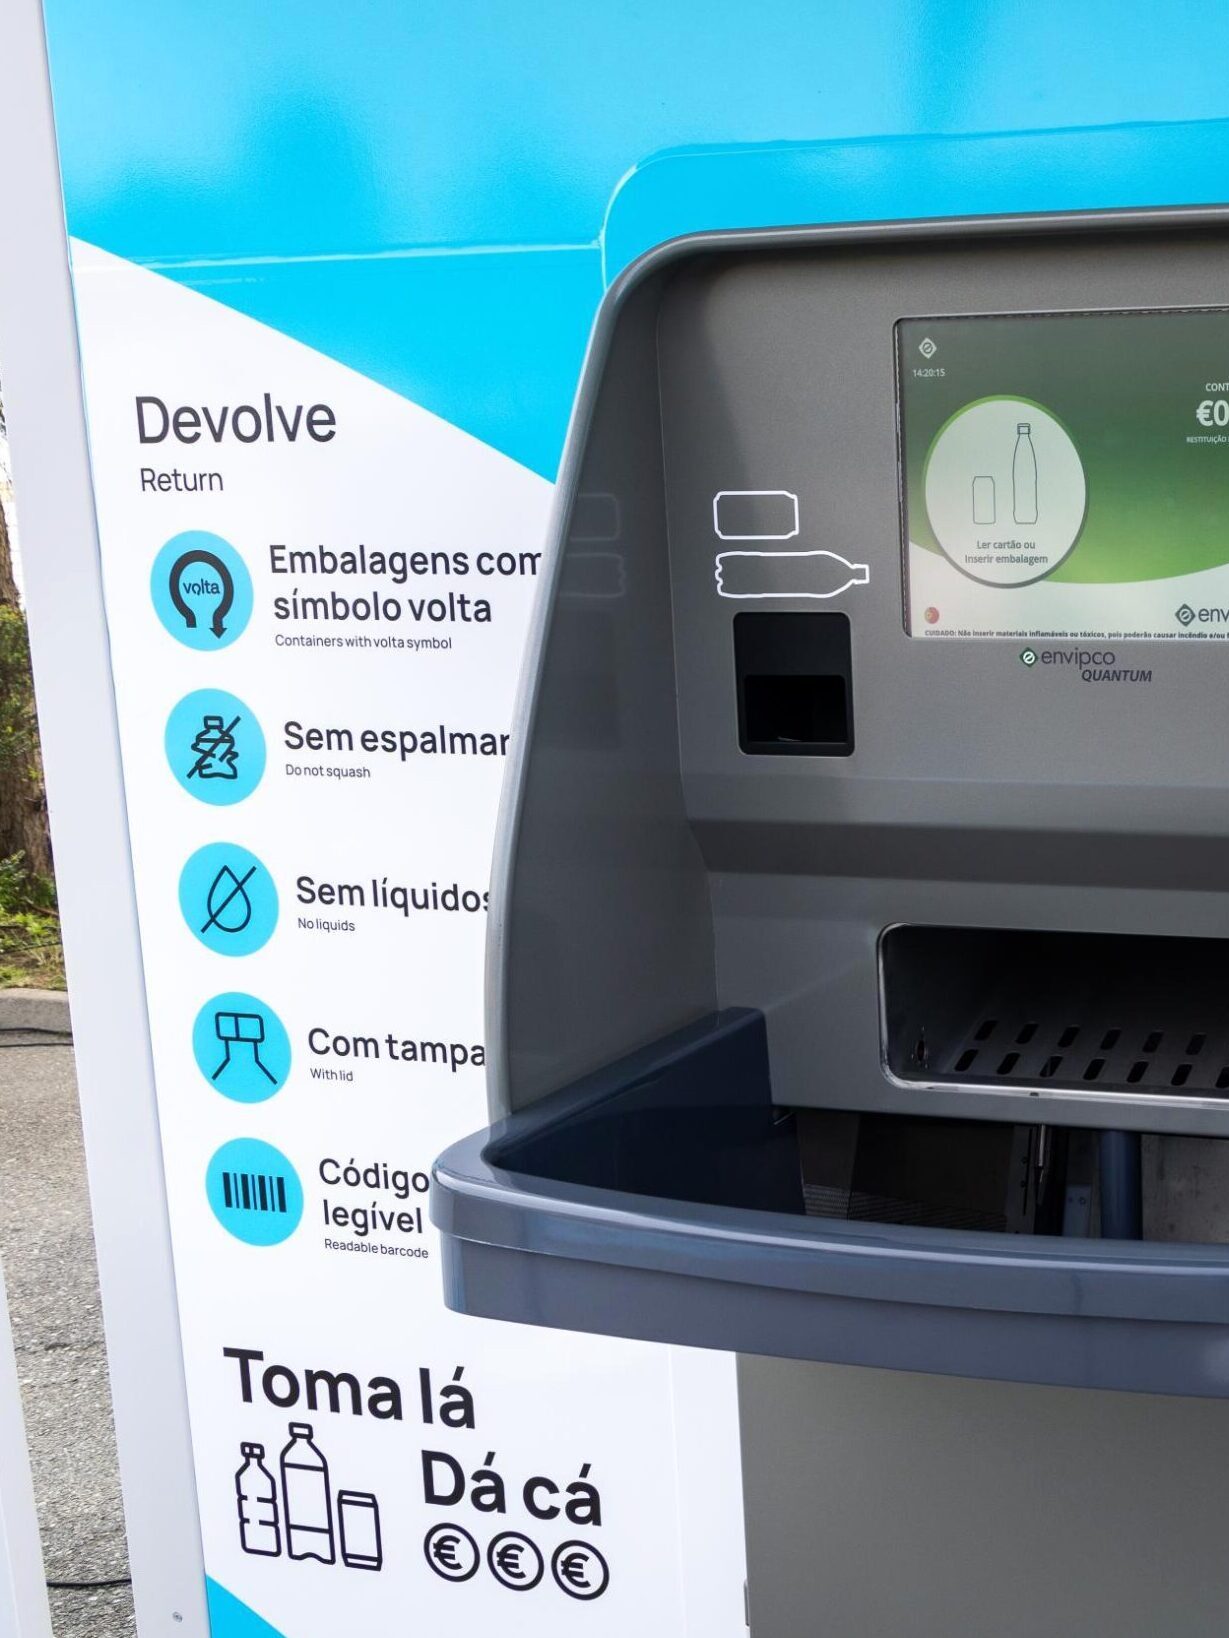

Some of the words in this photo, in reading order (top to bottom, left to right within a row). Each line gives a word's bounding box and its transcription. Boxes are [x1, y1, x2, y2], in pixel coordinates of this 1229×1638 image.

[912, 368, 946, 378] 14:20:15
[136, 393, 336, 444] Devolve
[141, 468, 223, 492] Return
[977, 541, 991, 549] Ler
[993, 540, 1021, 549] cartão
[270, 545, 469, 584] Embalagens
[965, 555, 994, 563] Inserir
[995, 554, 1048, 566] embalagem
[183, 578, 220, 596] volta
[274, 588, 401, 621] símbolo
[408, 592, 491, 622] volta
[275, 634, 343, 647] Containers
[345, 636, 372, 647] with
[373, 636, 404, 648] volta
[407, 637, 452, 651] symbol
[1041, 647, 1116, 670] envipco
[1081, 669, 1152, 682] QUANTUM
[284, 721, 353, 751] Sem
[361, 725, 510, 761] espalmar
[286, 764, 302, 776] Do
[304, 766, 324, 776] not
[327, 767, 370, 780] squash
[297, 876, 365, 906] Sem
[298, 918, 314, 929] No
[316, 919, 355, 933] liquids
[308, 1028, 379, 1058] Com
[385, 1034, 485, 1072] tampa
[310, 1068, 337, 1080] With
[339, 1070, 353, 1081] lid
[319, 1158, 430, 1199] Código
[323, 1199, 422, 1236] legível
[325, 1238, 378, 1253] Readable
[380, 1244, 428, 1258] barcode
[223, 1347, 402, 1420] Toma
[419, 1366, 475, 1429] lá
[421, 1450, 506, 1514] Dá
[523, 1463, 601, 1526] cá
[433, 1535, 463, 1570] €
[496, 1544, 526, 1579] €
[561, 1553, 591, 1588] €
